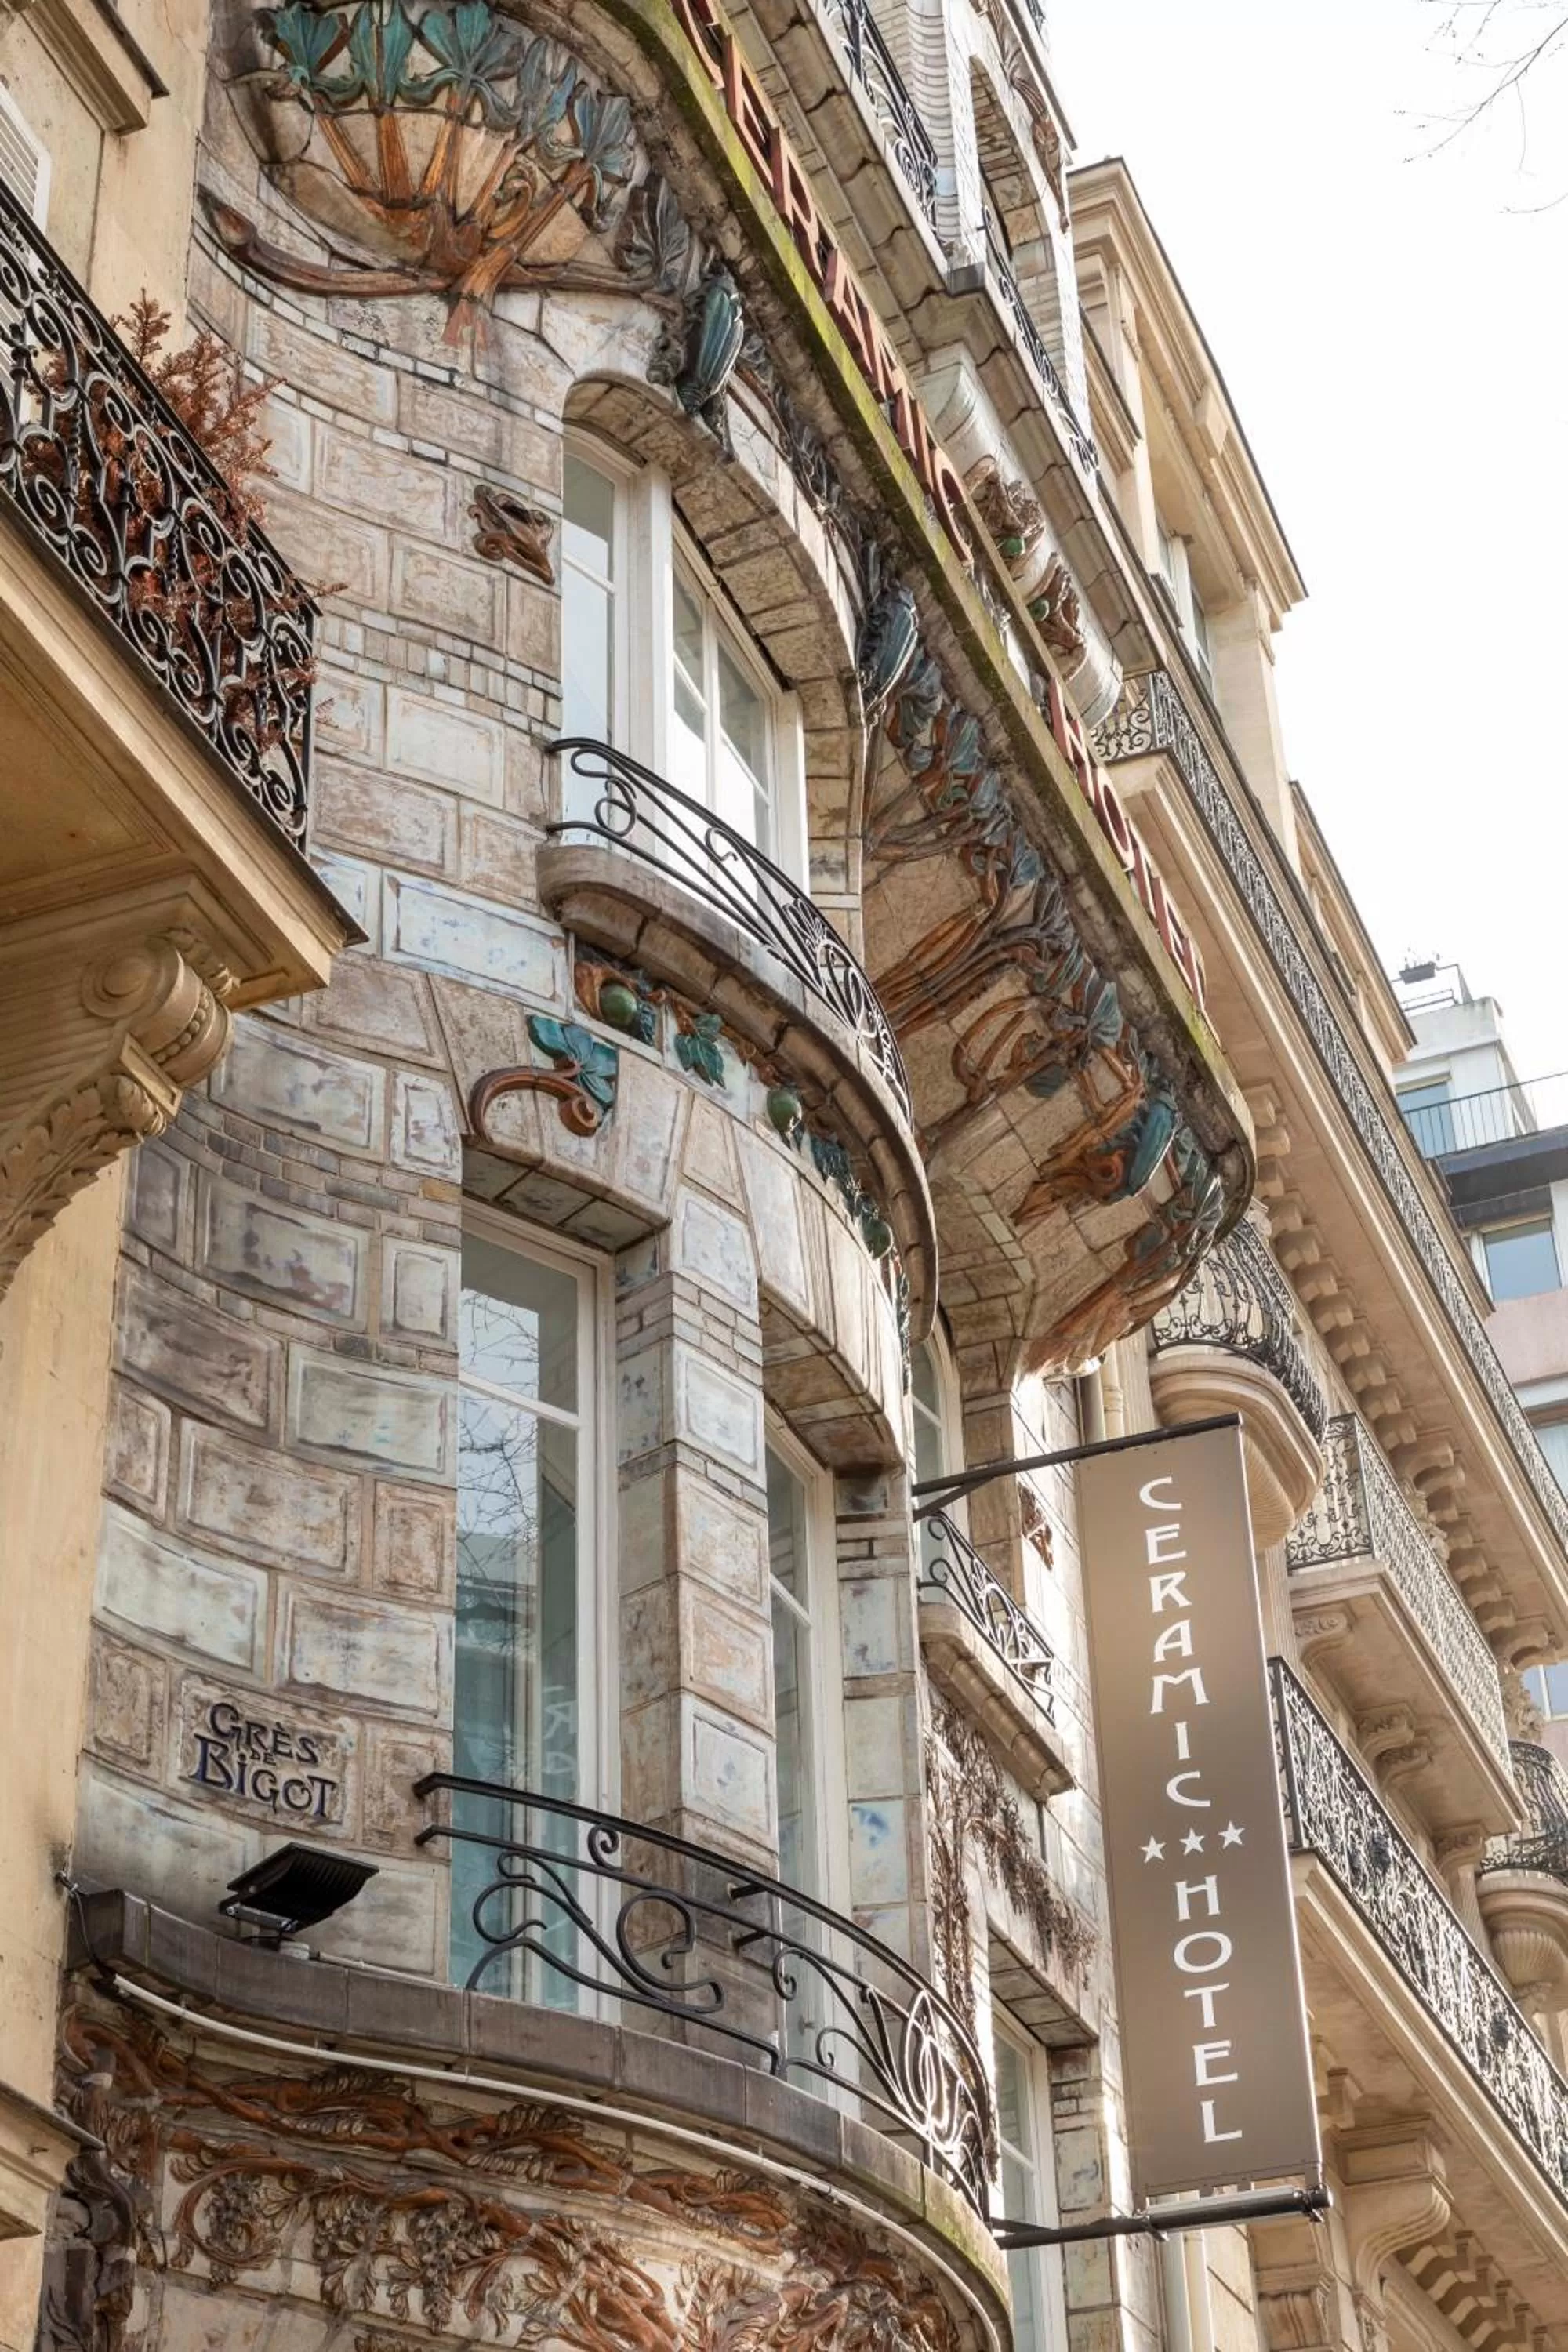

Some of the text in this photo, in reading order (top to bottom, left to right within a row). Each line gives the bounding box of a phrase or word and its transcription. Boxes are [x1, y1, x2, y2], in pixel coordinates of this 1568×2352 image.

[1047, 677, 1221, 1048] HOTEL
[209, 1702, 319, 1765] GRÈS
[249, 1747, 277, 1766] DE
[1139, 1476, 1243, 2143] CERAMIC HOTEL
